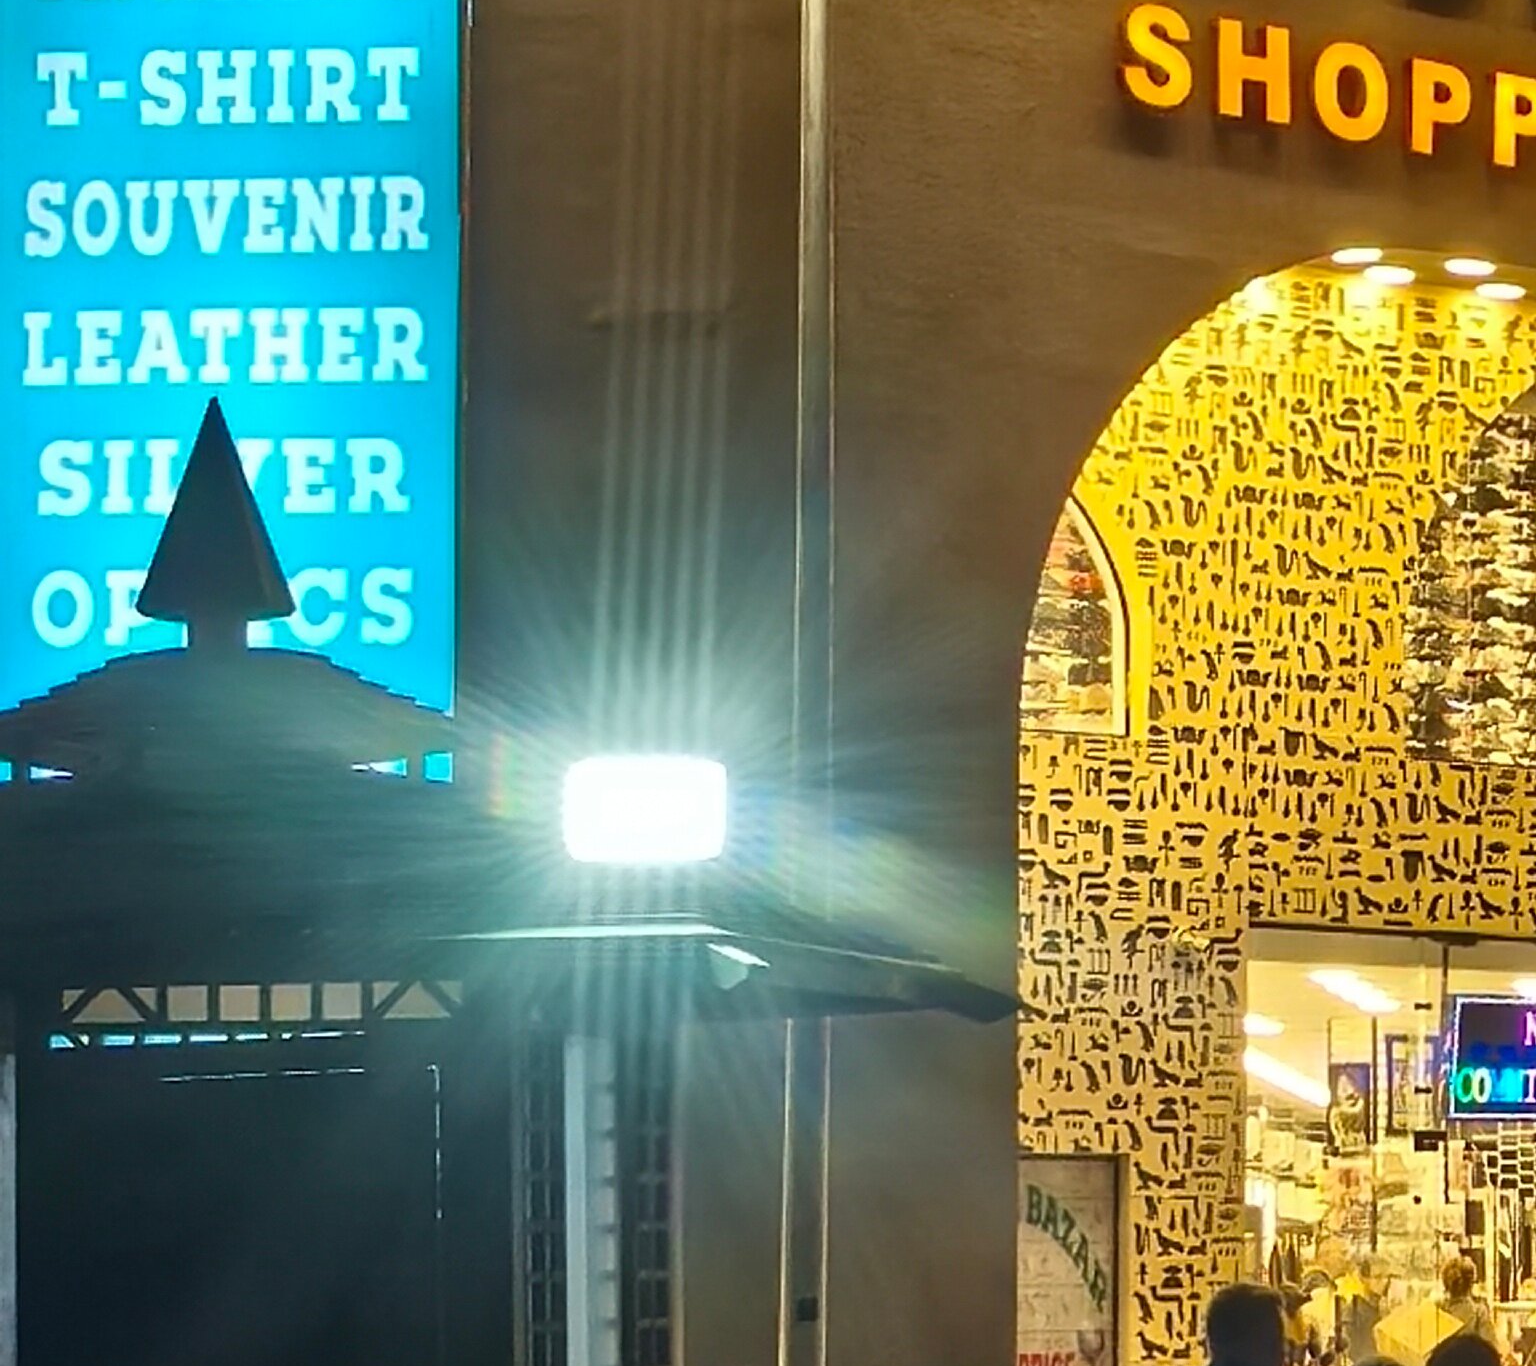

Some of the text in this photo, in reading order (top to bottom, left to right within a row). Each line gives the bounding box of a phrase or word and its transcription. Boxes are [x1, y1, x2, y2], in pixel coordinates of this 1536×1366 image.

[36, 46, 421, 127] T-SHIRT
[24, 175, 430, 259] SOUVENIR
[22, 307, 428, 387] LEATHER
[31, 567, 415, 649] OPCS
[1026, 1184, 1107, 1314] BAZAR
